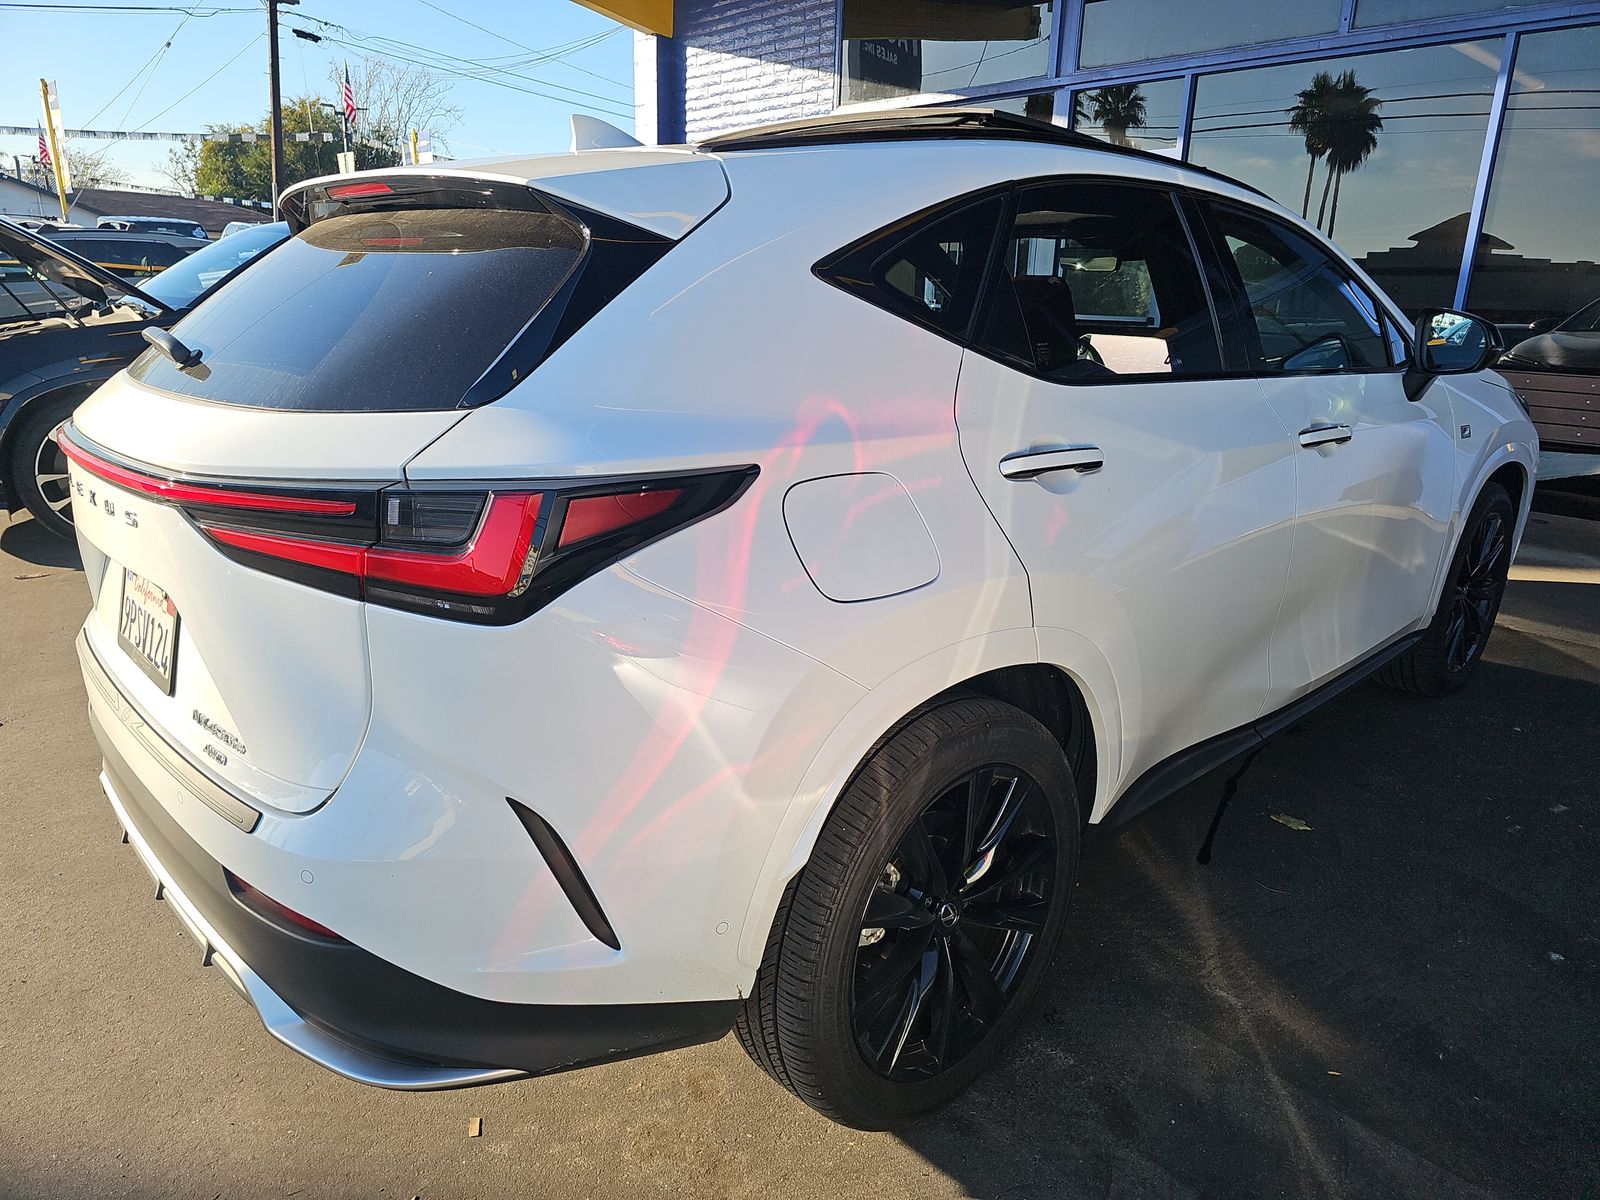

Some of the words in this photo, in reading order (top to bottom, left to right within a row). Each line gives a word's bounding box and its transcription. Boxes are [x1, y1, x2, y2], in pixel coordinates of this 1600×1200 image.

[133, 575, 165, 606] California
[122, 595, 169, 676] 9PSV124
[202, 744, 228, 766] AWD
